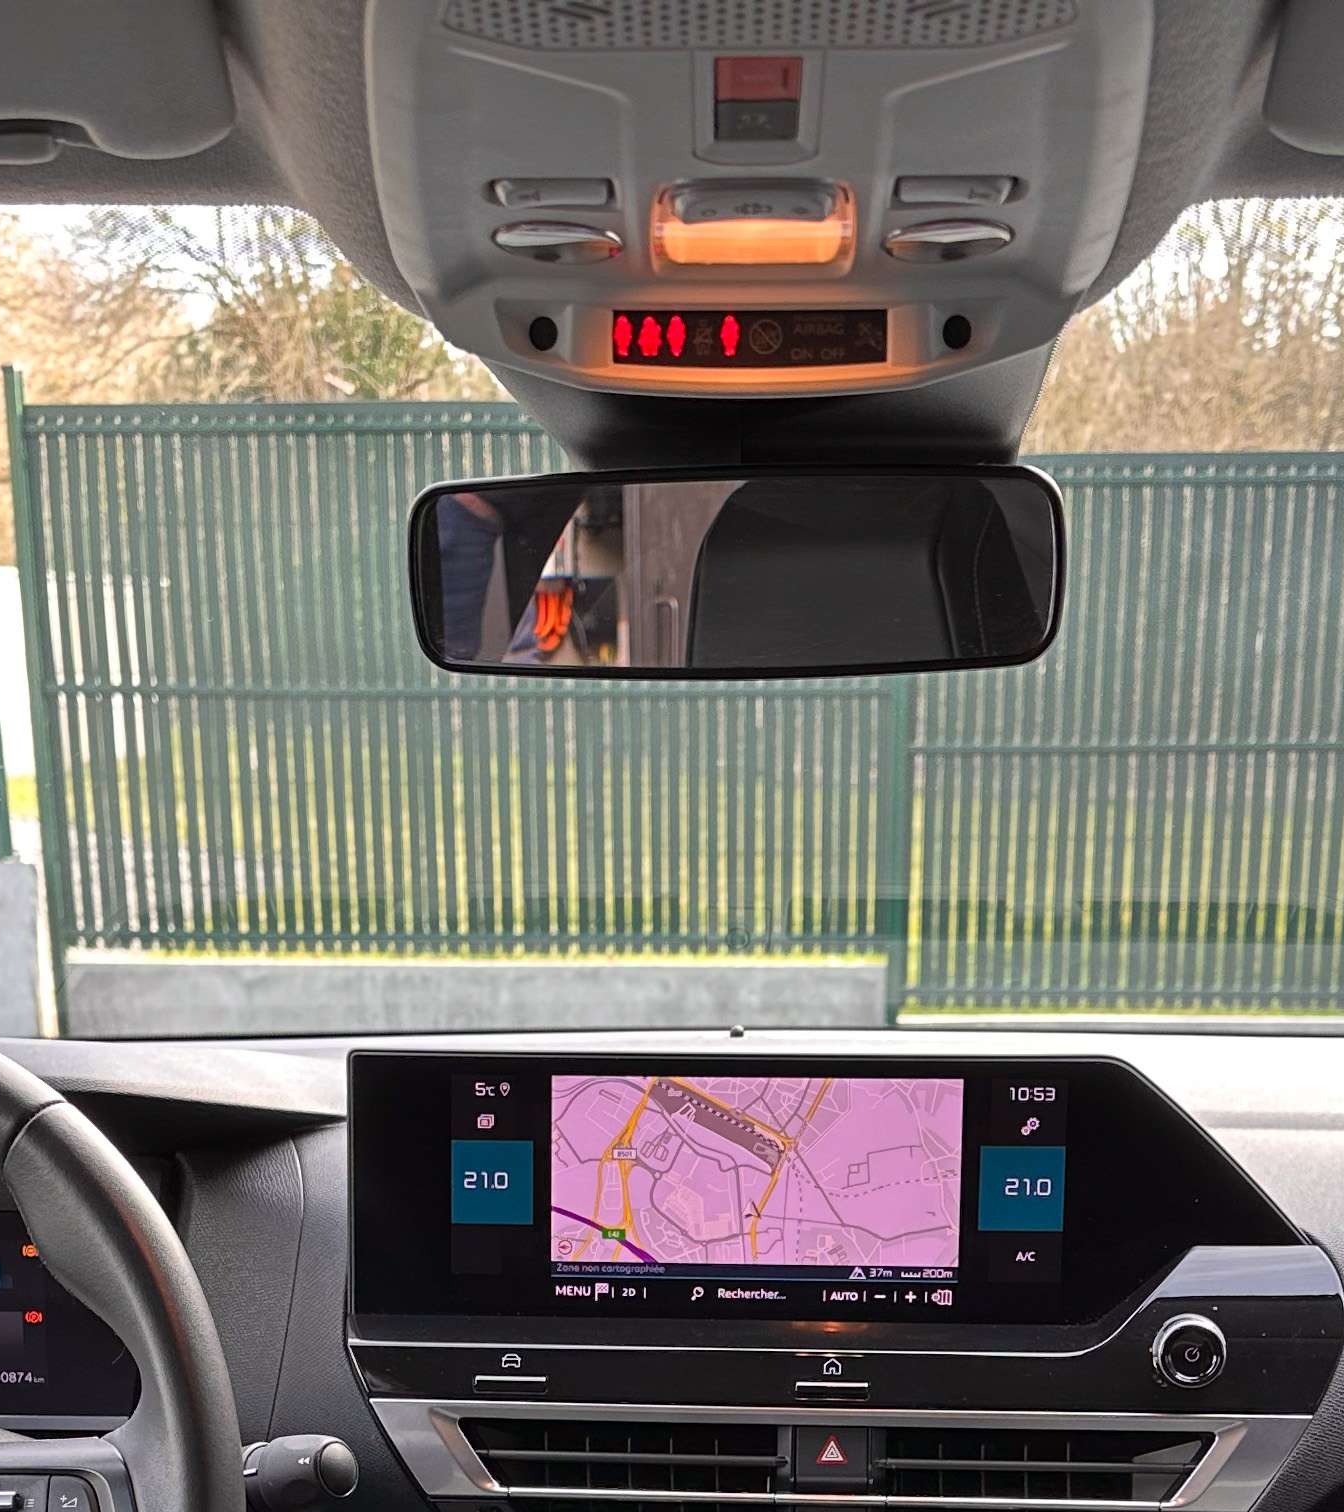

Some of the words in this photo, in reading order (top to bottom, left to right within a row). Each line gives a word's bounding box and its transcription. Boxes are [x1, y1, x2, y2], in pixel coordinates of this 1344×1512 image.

[1010, 1087, 1056, 1101] 10:53
[463, 1171, 509, 1189] 21.0
[1005, 1178, 1051, 1196] 21.0
[1015, 1251, 1036, 1261] A/C
[556, 1263, 579, 1272] Zone
[581, 1265, 600, 1273] non
[556, 1285, 591, 1297] MENU
[622, 1288, 636, 1297] 2D
[830, 1291, 858, 1301] AUTO
